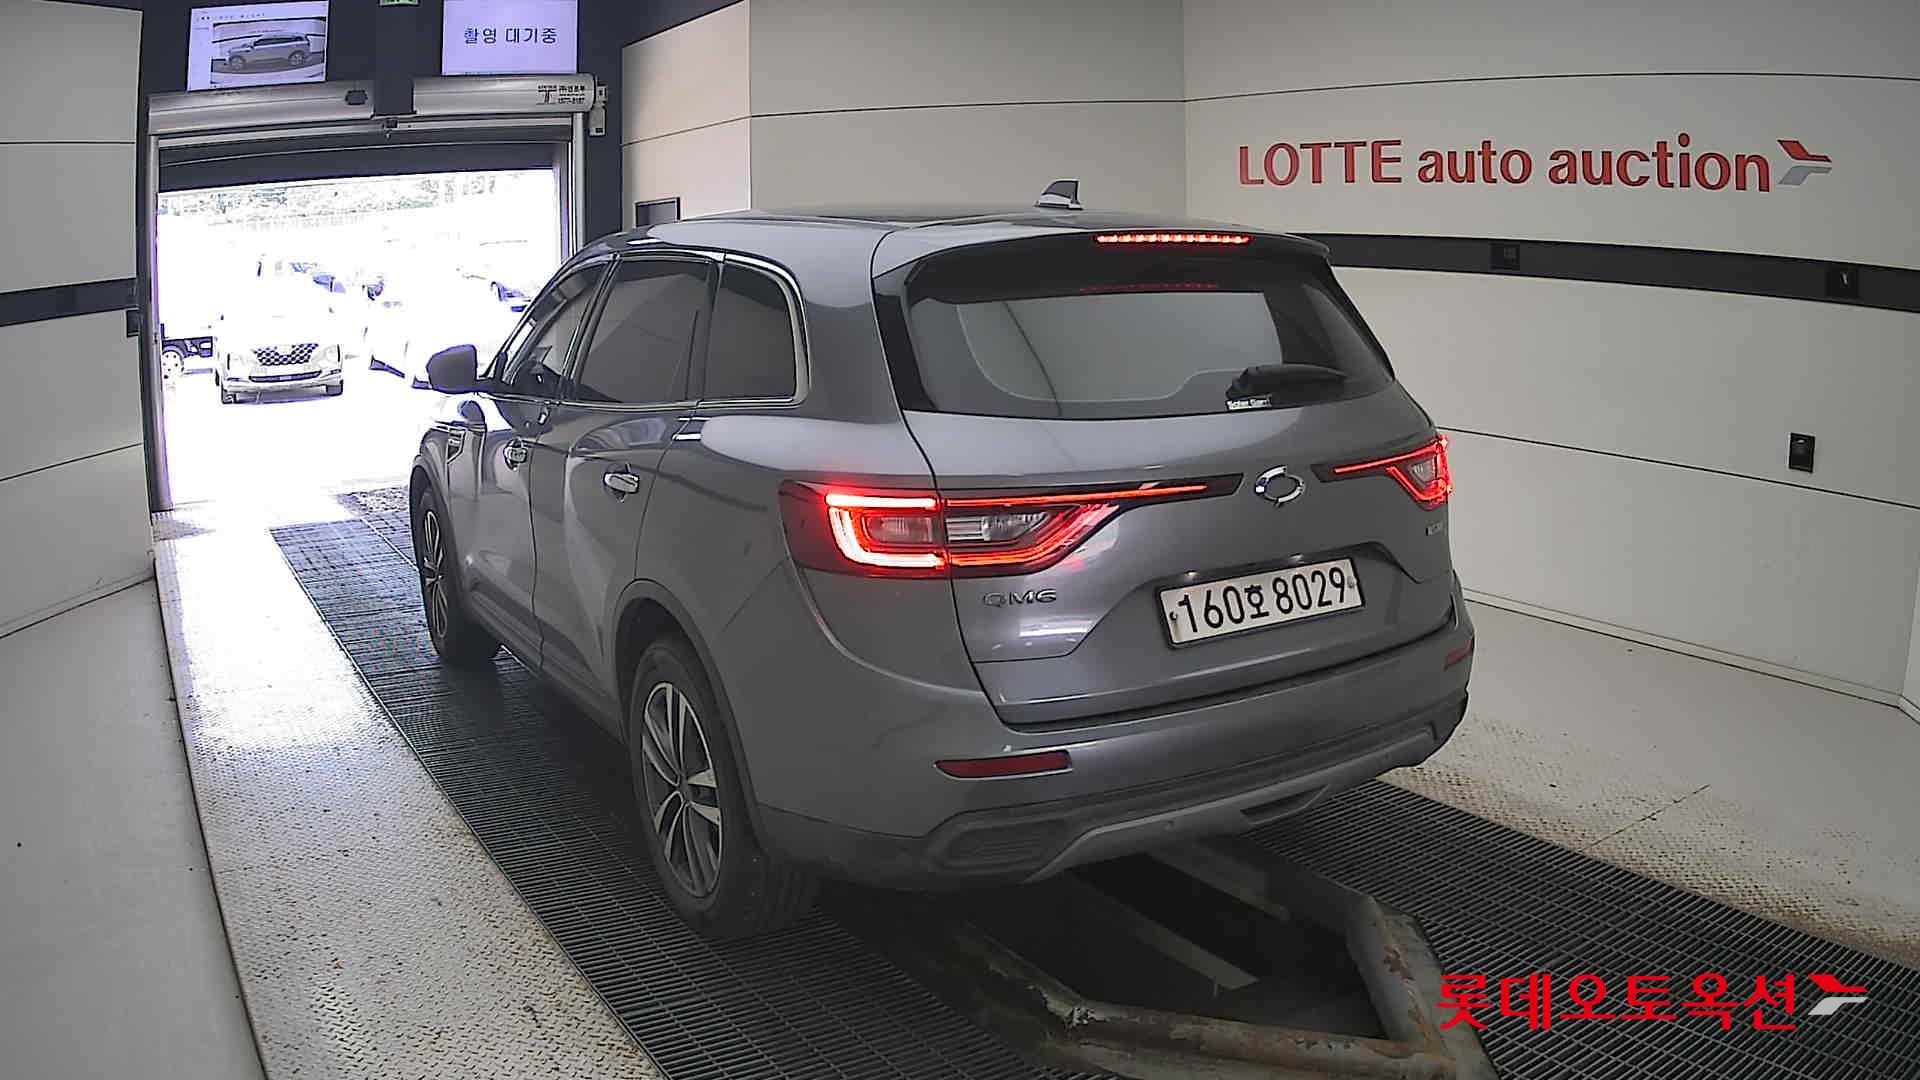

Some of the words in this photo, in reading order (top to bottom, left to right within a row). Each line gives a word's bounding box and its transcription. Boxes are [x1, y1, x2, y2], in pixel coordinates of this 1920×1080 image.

[464, 28, 497, 44] 촬영
[505, 28, 557, 44] 대기중
[1239, 139, 1402, 186] LOTTE
[1417, 140, 1533, 184] auto
[1548, 133, 1770, 193] auction
[983, 588, 1057, 607] QM6
